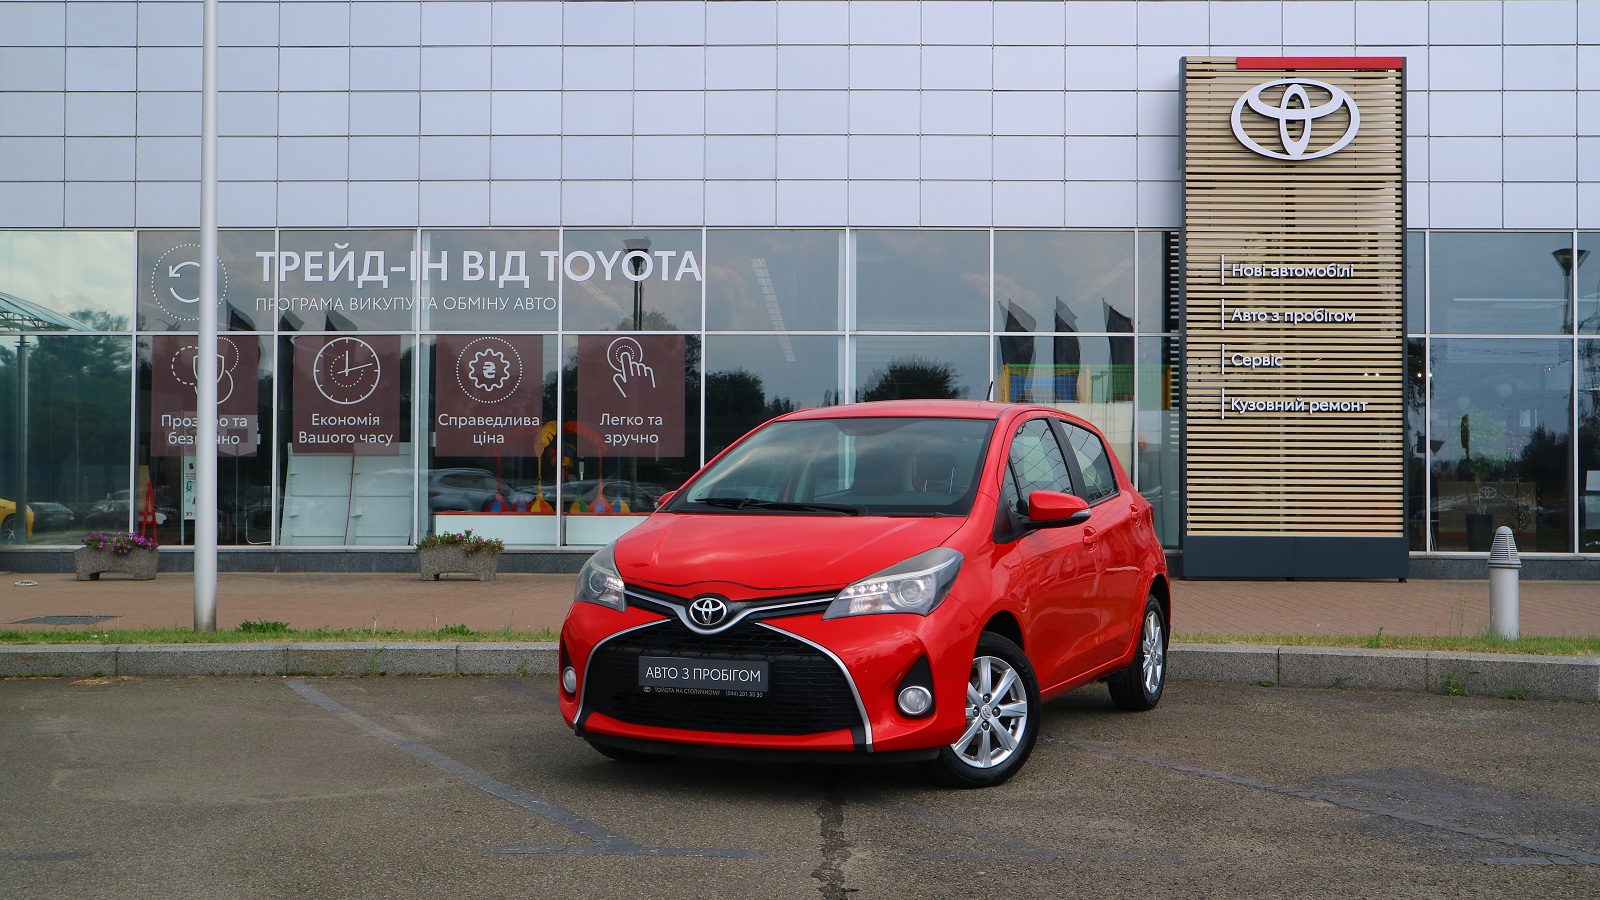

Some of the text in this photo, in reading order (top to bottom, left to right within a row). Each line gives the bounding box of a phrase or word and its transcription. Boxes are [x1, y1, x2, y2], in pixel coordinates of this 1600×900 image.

[255, 242, 702, 289] ТРЕЙД-ІН ВІД TOYOTA
[1231, 263, 1355, 278] Нові автомобілі
[256, 297, 557, 311] ПРОГРАМА ВИКУПУ ТА ОБМІНУ АВТО
[1231, 308, 1356, 326] Авто з пробігом
[1231, 353, 1284, 370] Сервіс
[1231, 397, 1368, 415] Кузовний ремонт
[161, 414, 248, 430] Прозо та
[311, 412, 380, 426] Економія
[438, 413, 540, 428] Справедлива
[600, 413, 663, 426] Легко та
[298, 431, 394, 447] Вашого часу
[473, 431, 505, 444] ціна
[604, 433, 659, 447] зручно
[645, 666, 679, 680] АВТО
[693, 668, 761, 683] ПРОБІГОМ
